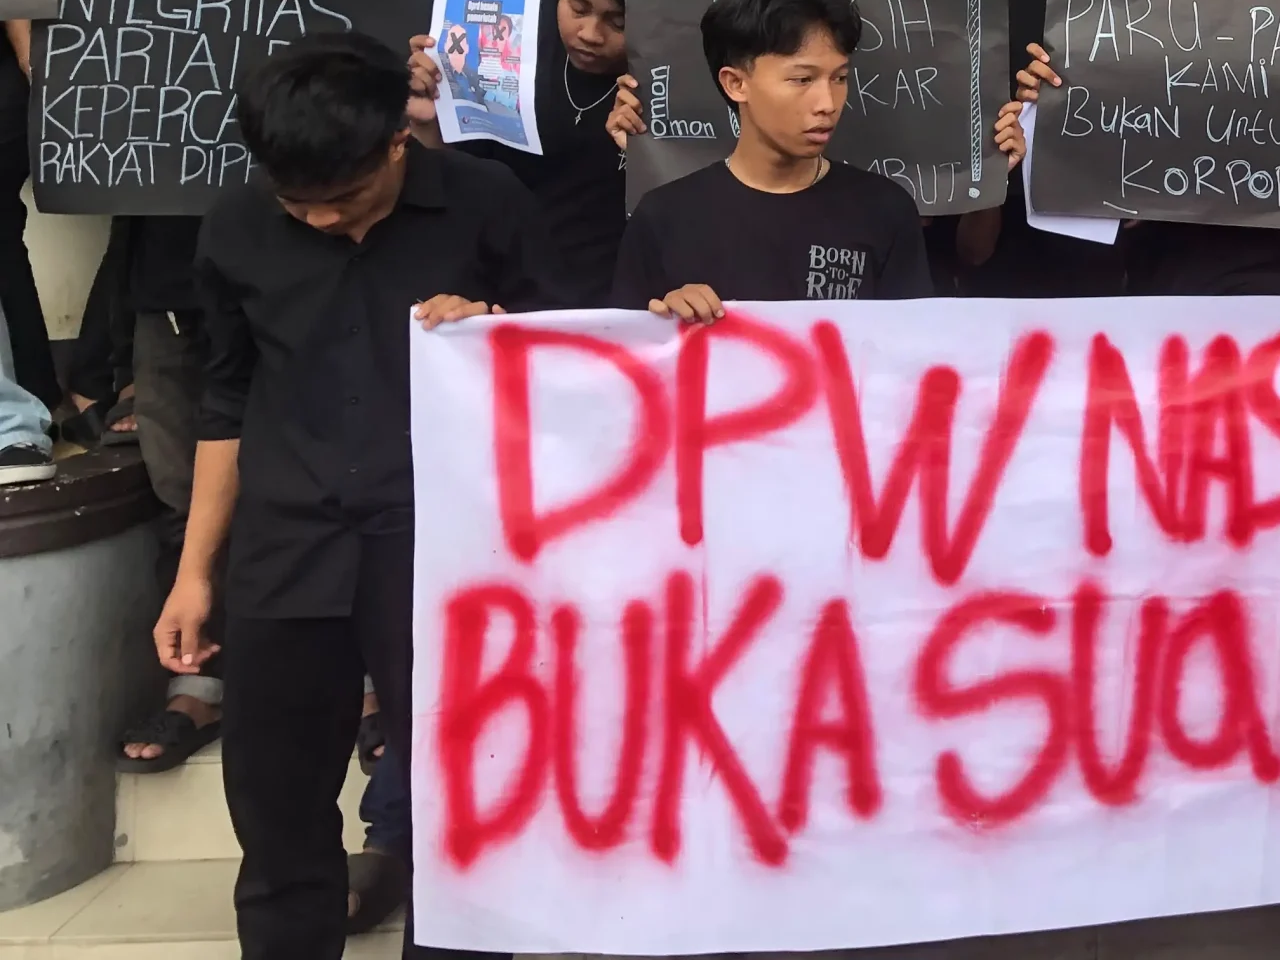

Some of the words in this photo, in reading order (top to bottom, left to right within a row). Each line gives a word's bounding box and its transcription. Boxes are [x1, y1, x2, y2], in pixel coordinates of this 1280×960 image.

[44, 23, 241, 90] PARTAI
[41, 84, 239, 145] KEPERCA
[845, 66, 944, 116] KAR
[39, 140, 171, 188] RAKYAT
[808, 244, 867, 276] BORN
[486, 314, 1056, 588] DPW
[436, 569, 883, 870] BUKA
